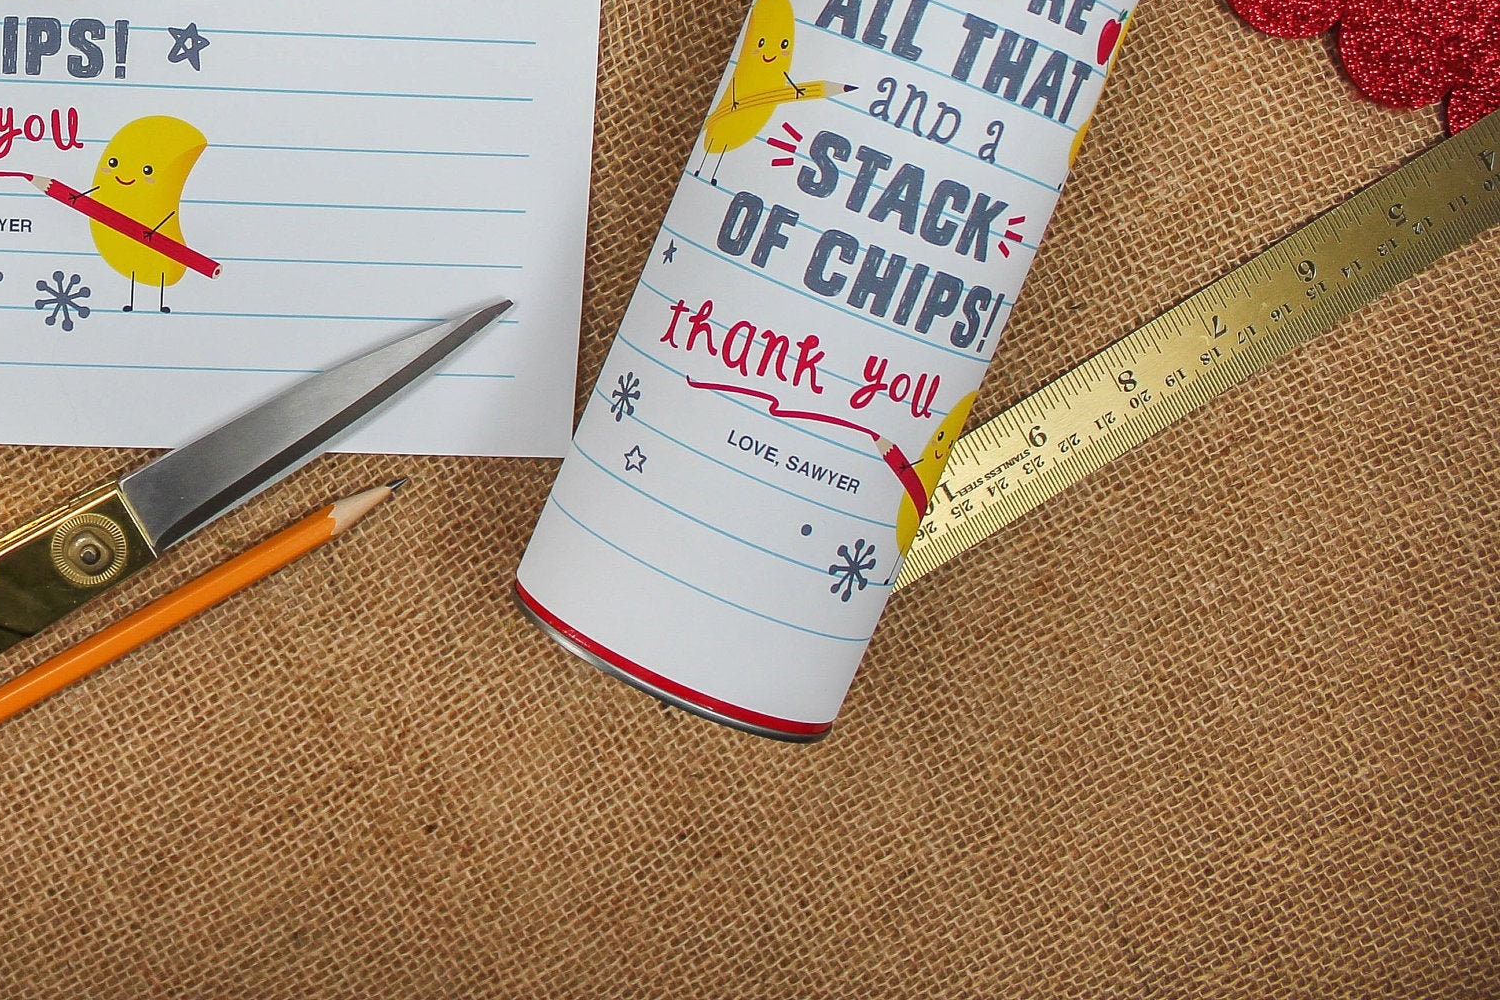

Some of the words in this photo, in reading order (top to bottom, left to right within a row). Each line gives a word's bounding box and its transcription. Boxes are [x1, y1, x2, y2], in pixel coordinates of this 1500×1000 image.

[951, 12, 1093, 124] THAT
[978, 119, 1005, 164] a
[797, 130, 1010, 263] STACK
[717, 190, 800, 269] OF
[803, 229, 1007, 353] CHIPS!
[659, 299, 826, 395] thank
[1211, 315, 1228, 339] 7
[1117, 370, 1137, 393] 8
[1028, 425, 1048, 448] 9
[726, 429, 780, 470] LOVE,
[785, 456, 862, 495] SAWYER
[986, 449, 1031, 482] STAINLESS
[955, 474, 986, 497] STEEL
